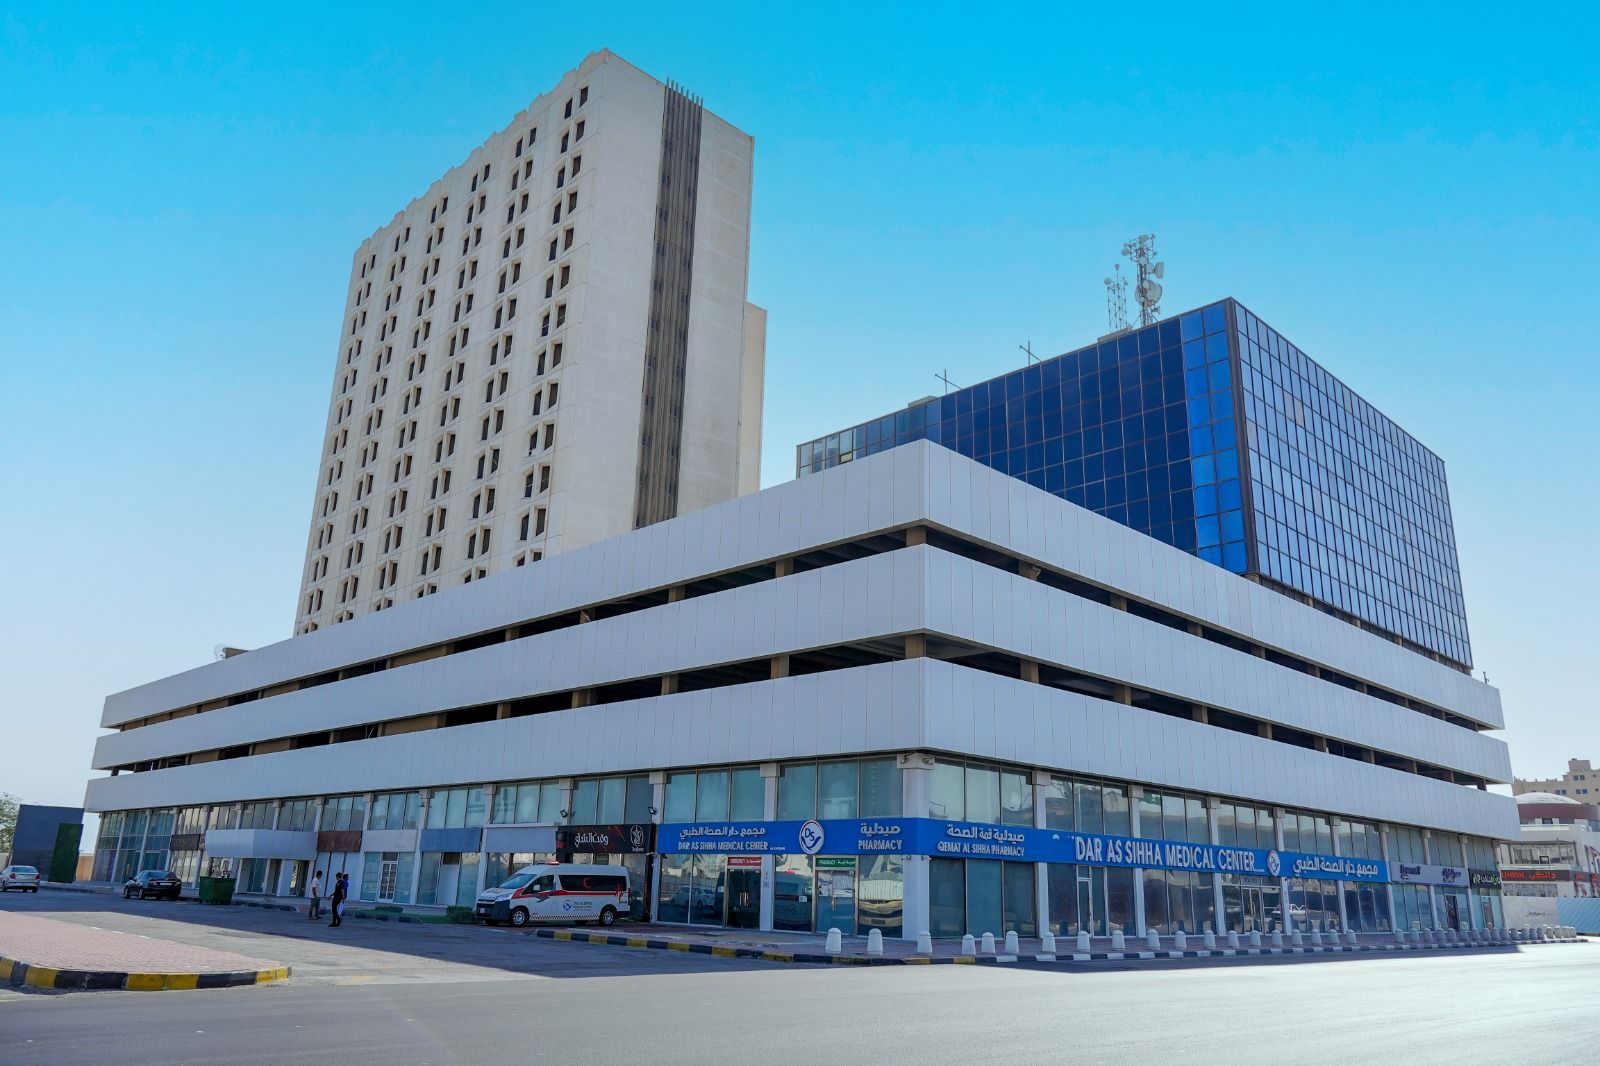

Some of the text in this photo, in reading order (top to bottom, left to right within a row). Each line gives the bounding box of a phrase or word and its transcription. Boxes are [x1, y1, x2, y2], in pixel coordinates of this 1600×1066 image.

[680, 826, 766, 840] مجمع دار الصحة الطبي
[860, 822, 901, 837] صيدلية
[947, 824, 1025, 844] صيدلية قمة الصحة
[678, 841, 690, 850] DAR
[691, 841, 699, 850] AS
[700, 841, 717, 850] SIHHA
[718, 841, 744, 851] MEDICAL
[745, 841, 769, 851] CENTER
[858, 839, 903, 850] PHARMACY
[962, 843, 971, 853] AL
[972, 844, 991, 855] SIHHA
[991, 845, 1025, 857] PHARMACY
[1075, 836, 1255, 872] DAR AS SIHHA MEDICAL CENTER
[1293, 855, 1379, 878] مجمع دار الصحة الطبي
